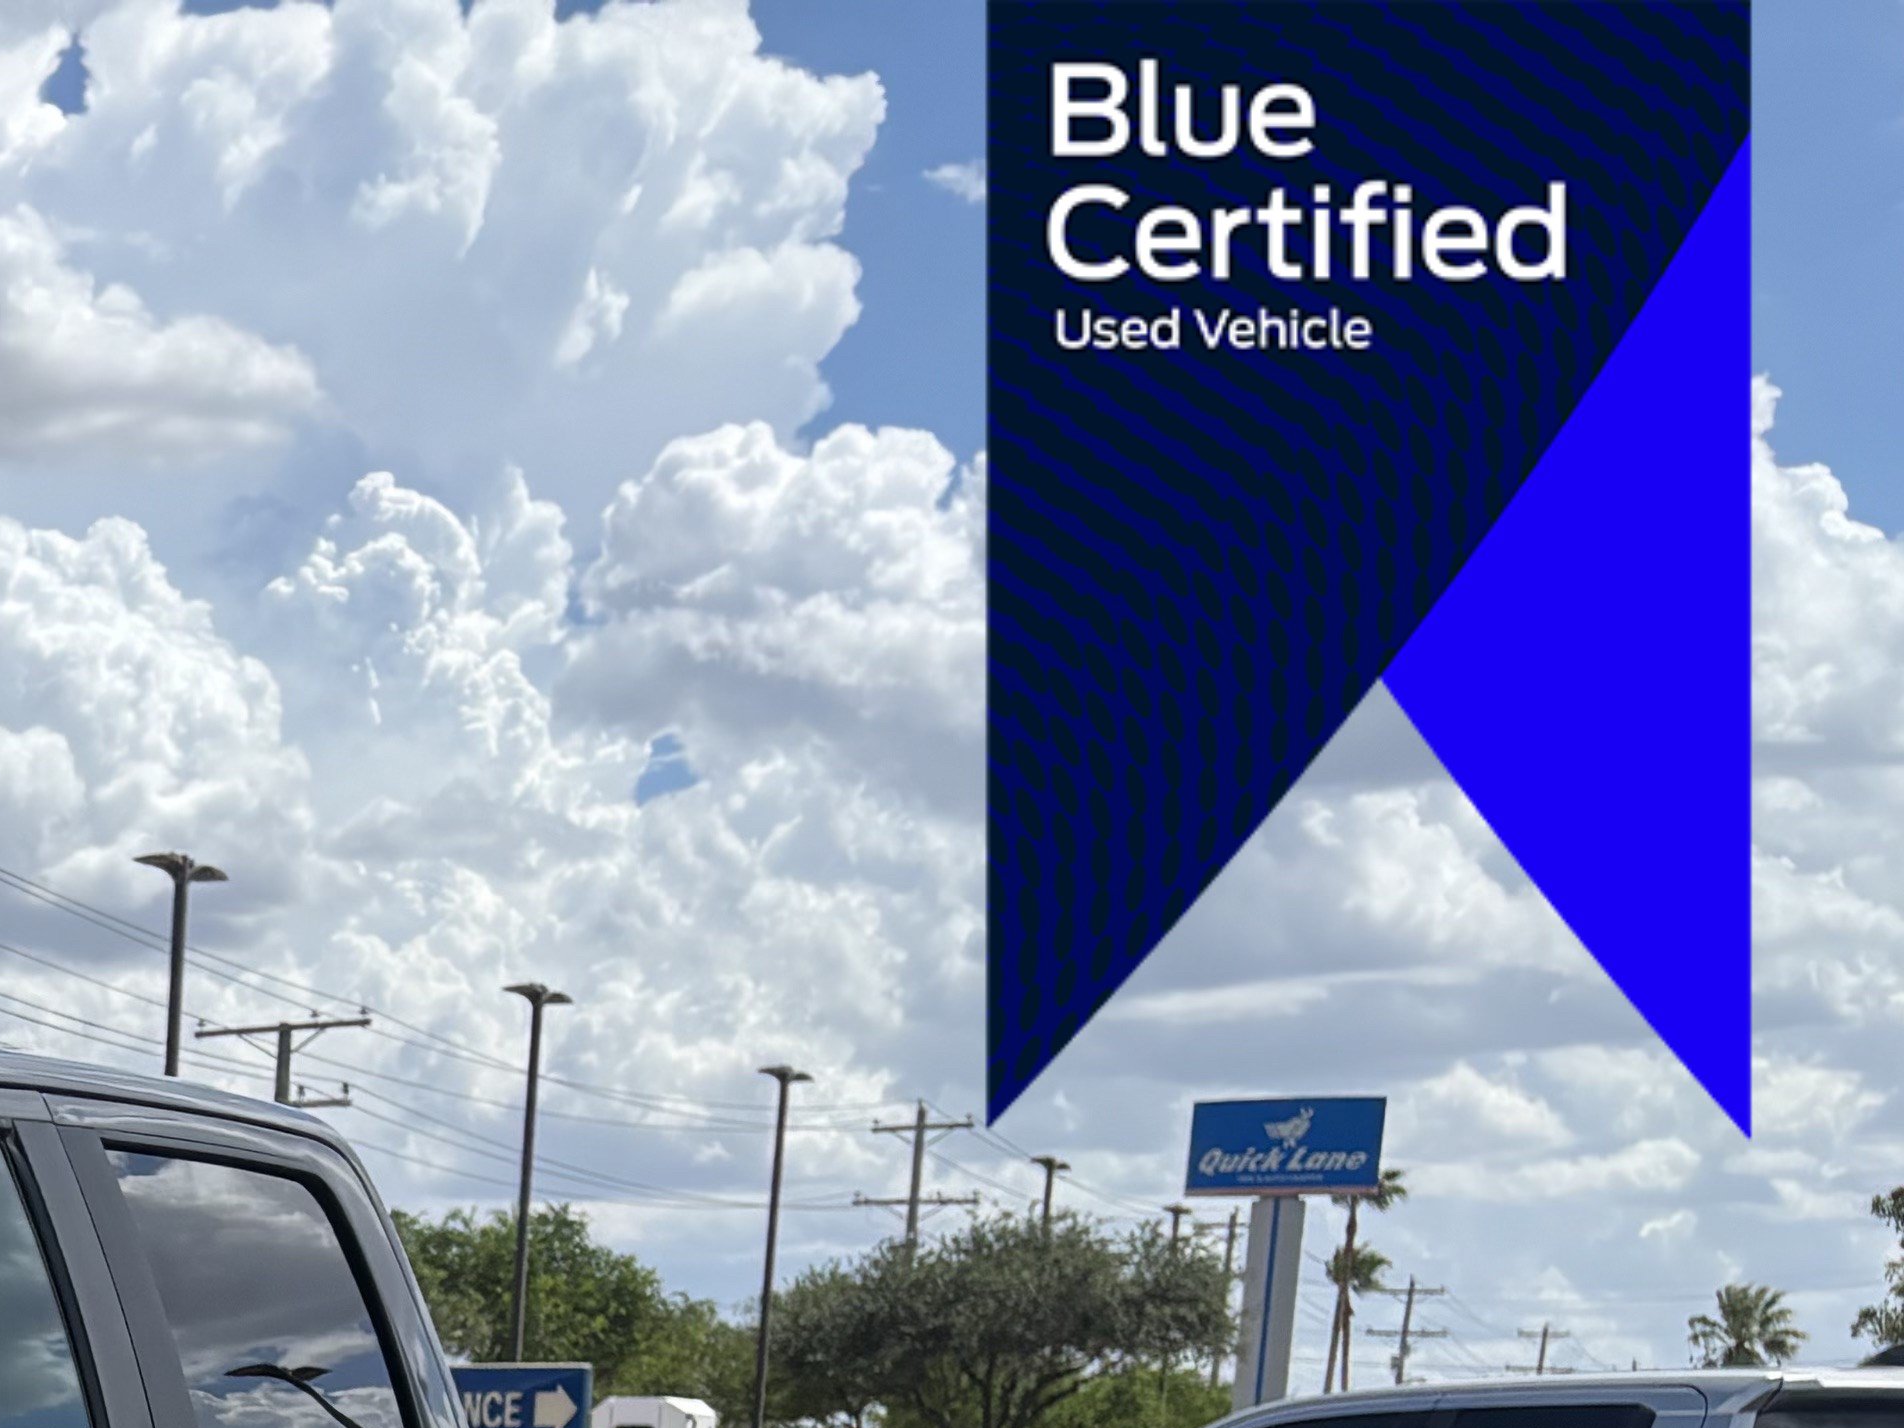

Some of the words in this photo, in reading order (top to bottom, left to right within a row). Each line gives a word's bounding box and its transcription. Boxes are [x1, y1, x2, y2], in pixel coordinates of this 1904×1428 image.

[1198, 1147, 1285, 1178] Quick
[1286, 1146, 1368, 1172] Lane
[463, 1391, 523, 1428] NCE
